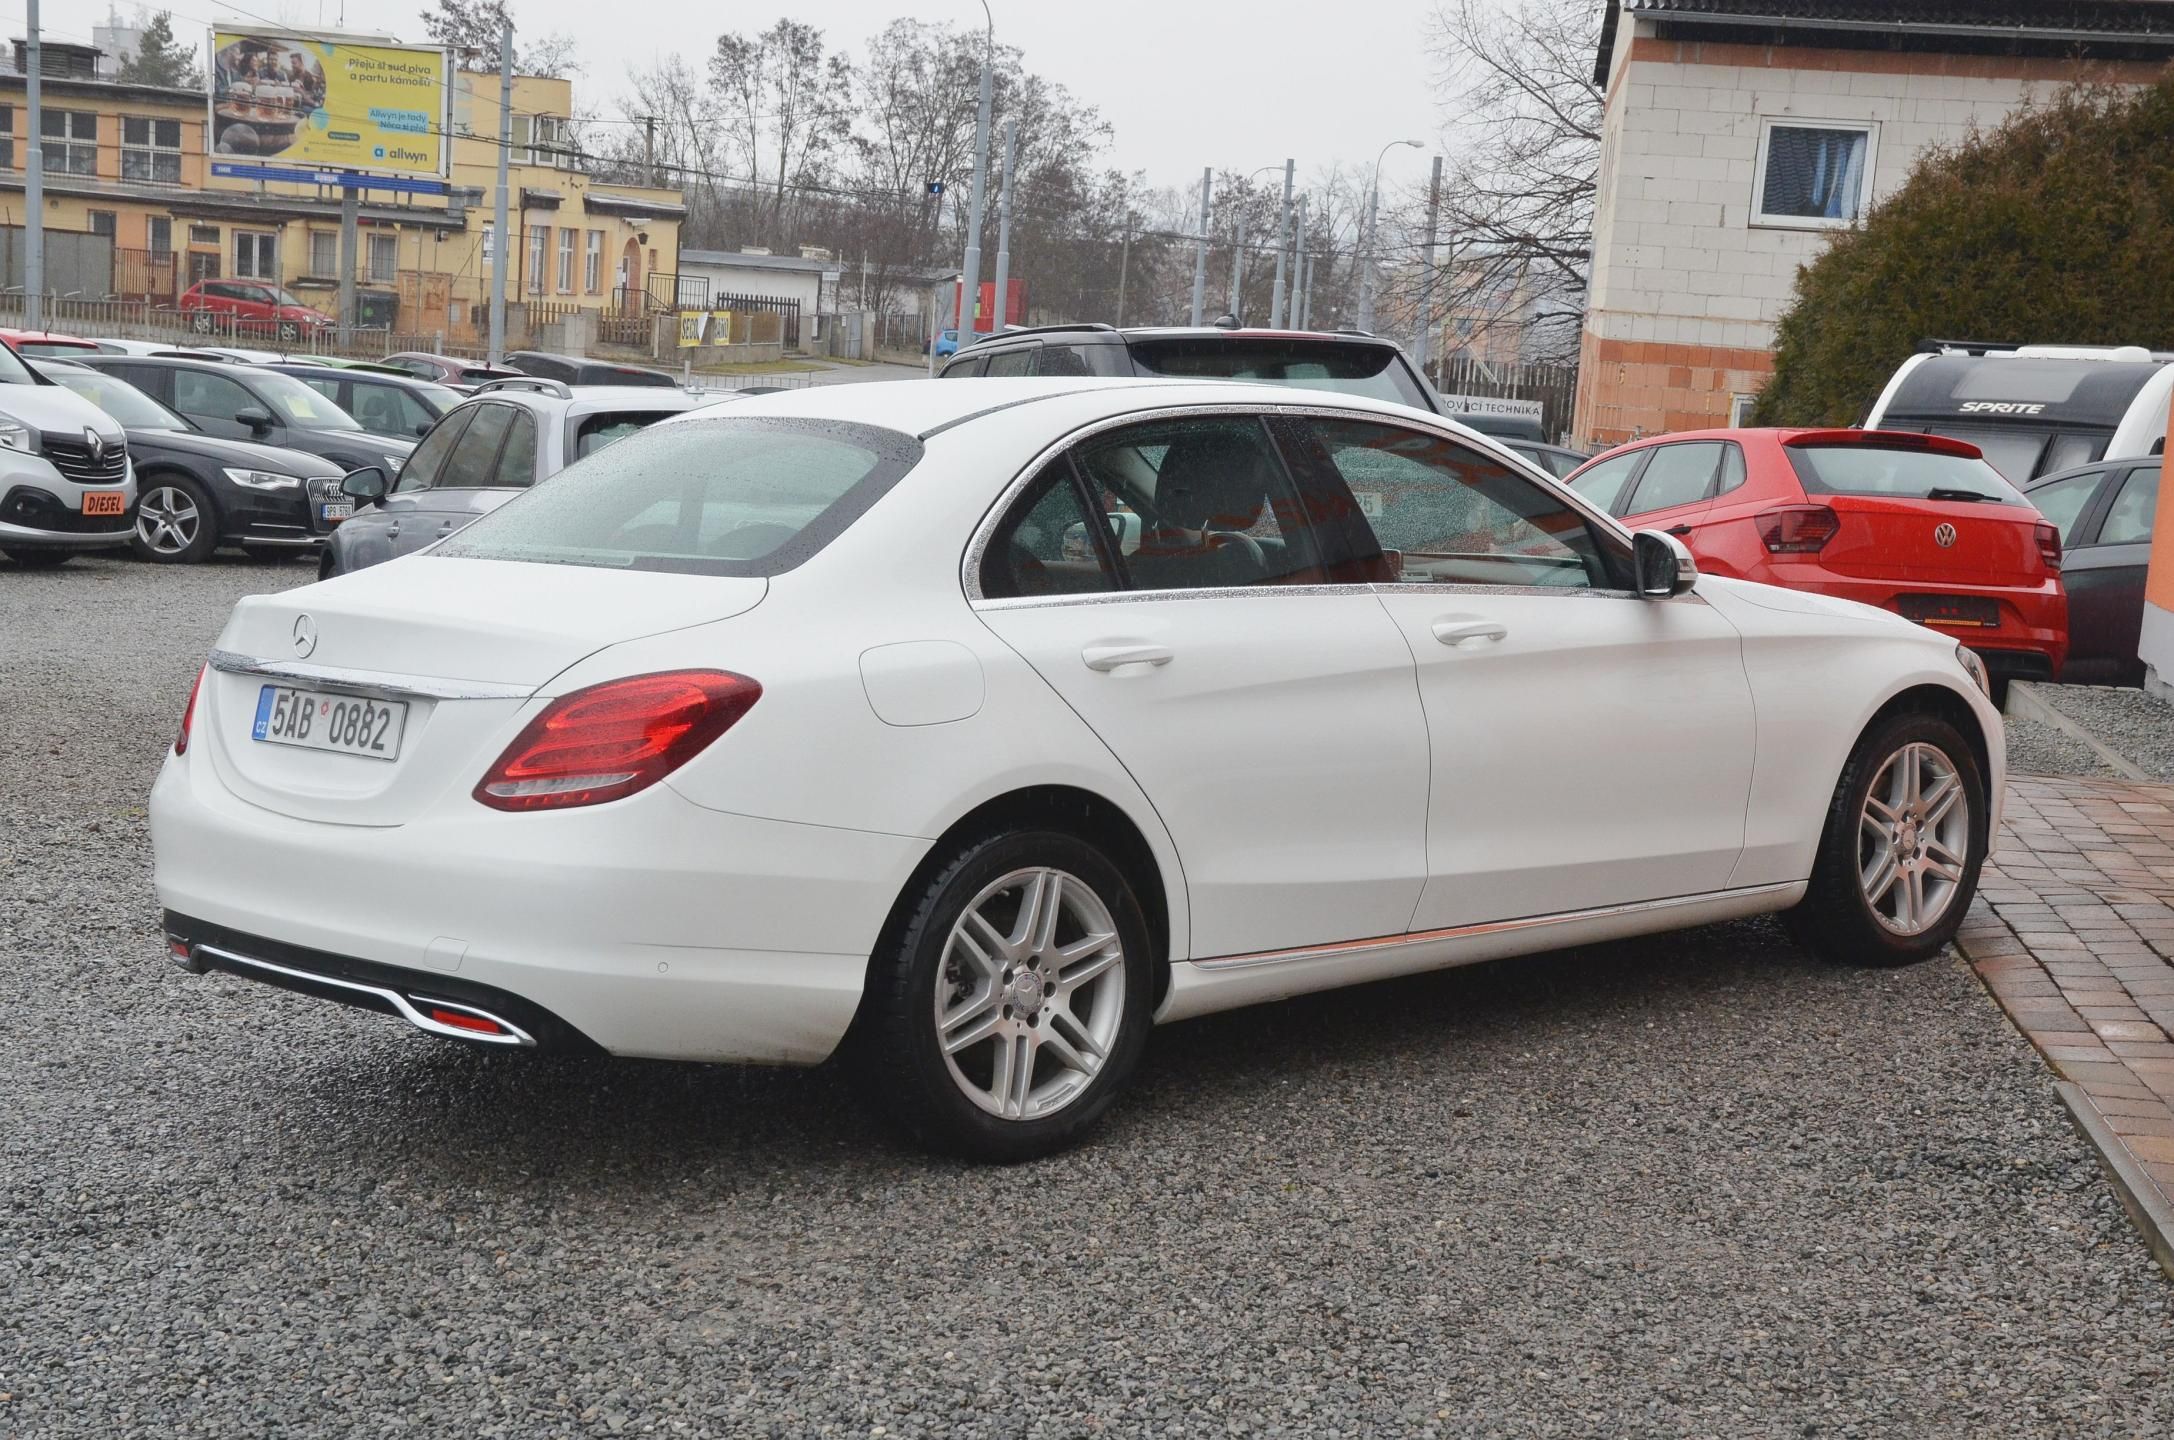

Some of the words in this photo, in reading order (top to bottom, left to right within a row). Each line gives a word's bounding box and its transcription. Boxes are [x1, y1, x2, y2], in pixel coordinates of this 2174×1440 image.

[349, 58, 375, 71] Přeju
[388, 63, 406, 72] sud
[408, 65, 431, 75] piva
[359, 73, 388, 84] partu
[390, 75, 431, 87] kámošů
[370, 109, 397, 121] Allwyn
[398, 112, 406, 121] je
[407, 112, 426, 122] tady
[389, 147, 428, 164] allwyn
[682, 317, 700, 340] SECO
[1486, 403, 1540, 416] TECHNIKA
[88, 496, 121, 512] DIESEL
[256, 721, 267, 734] CZ
[272, 694, 315, 739] 5AB
[329, 702, 391, 751] 0882
